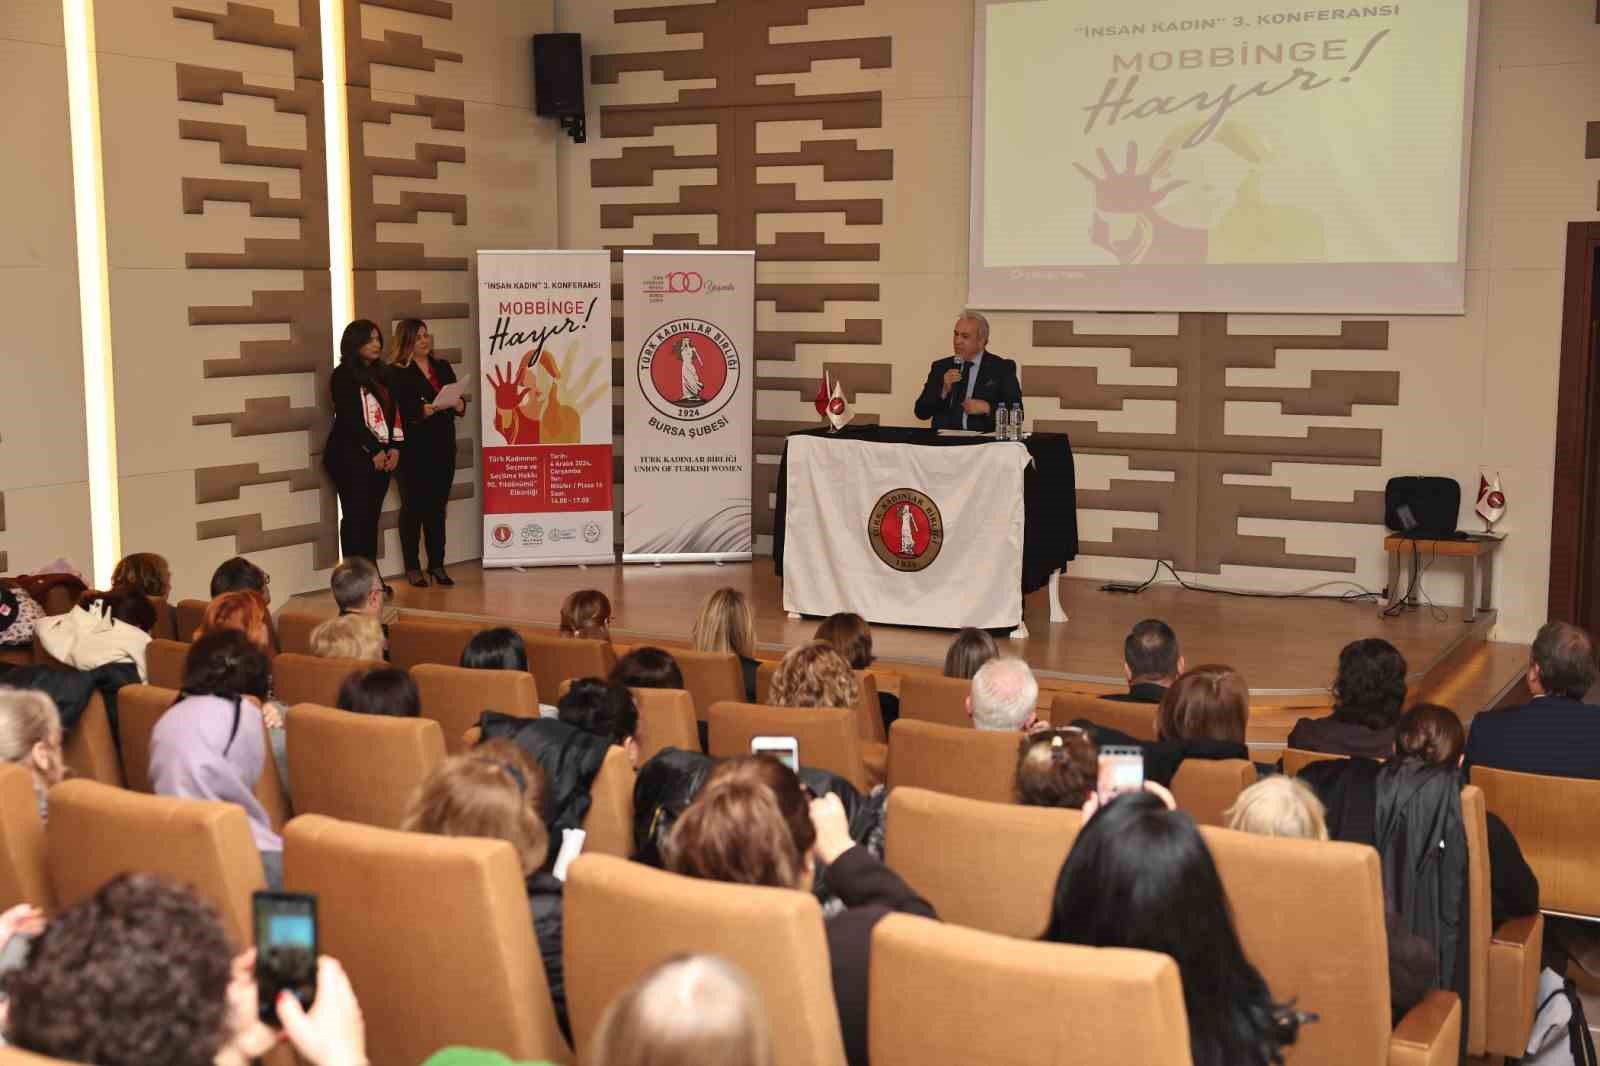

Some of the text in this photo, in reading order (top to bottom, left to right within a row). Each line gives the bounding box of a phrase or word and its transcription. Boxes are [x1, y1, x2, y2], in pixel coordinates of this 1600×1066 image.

[1152, 17, 1225, 33] KADIN"
[1233, 16, 1250, 28] 3.
[1257, 5, 1400, 25] KONFERANSI
[1113, 39, 1348, 73] MOBBİNGE
[1081, 29, 1391, 150] Hayır!
[514, 281, 542, 290] KADIN"
[552, 281, 601, 289] KONFERANSI
[499, 298, 585, 316] MOBBİNGE
[489, 297, 598, 368] Hayır!
[641, 322, 739, 371] TÜRK KADINLAR BİRLİĞİ
[677, 408, 701, 418] 1924
[648, 415, 730, 439] BURSA ŞUBESİ
[634, 465, 743, 473] UNION OF TURKISH WOMEN
[640, 456, 661, 464] TÜRK
[663, 456, 706, 464] KADINLAR
